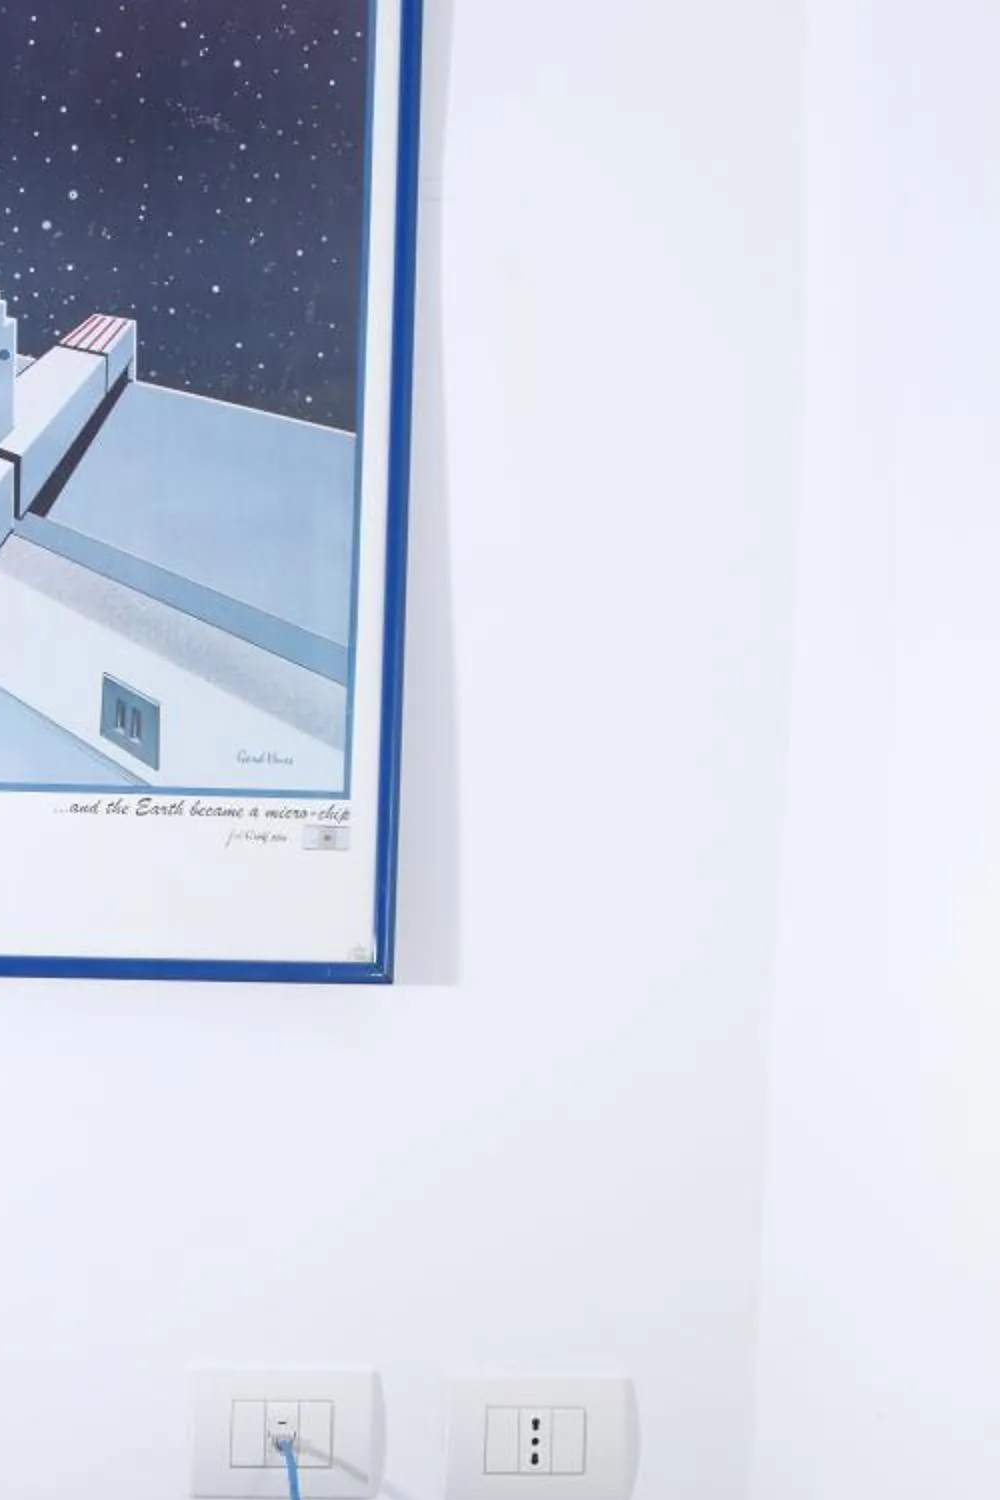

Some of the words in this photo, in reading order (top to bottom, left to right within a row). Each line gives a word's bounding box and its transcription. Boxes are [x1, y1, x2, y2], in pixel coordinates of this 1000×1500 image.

[105, 798, 129, 815] the
[135, 797, 185, 817] Earth
[189, 800, 244, 818] became
[249, 807, 259, 818] a
[265, 803, 350, 824] micro-chip
